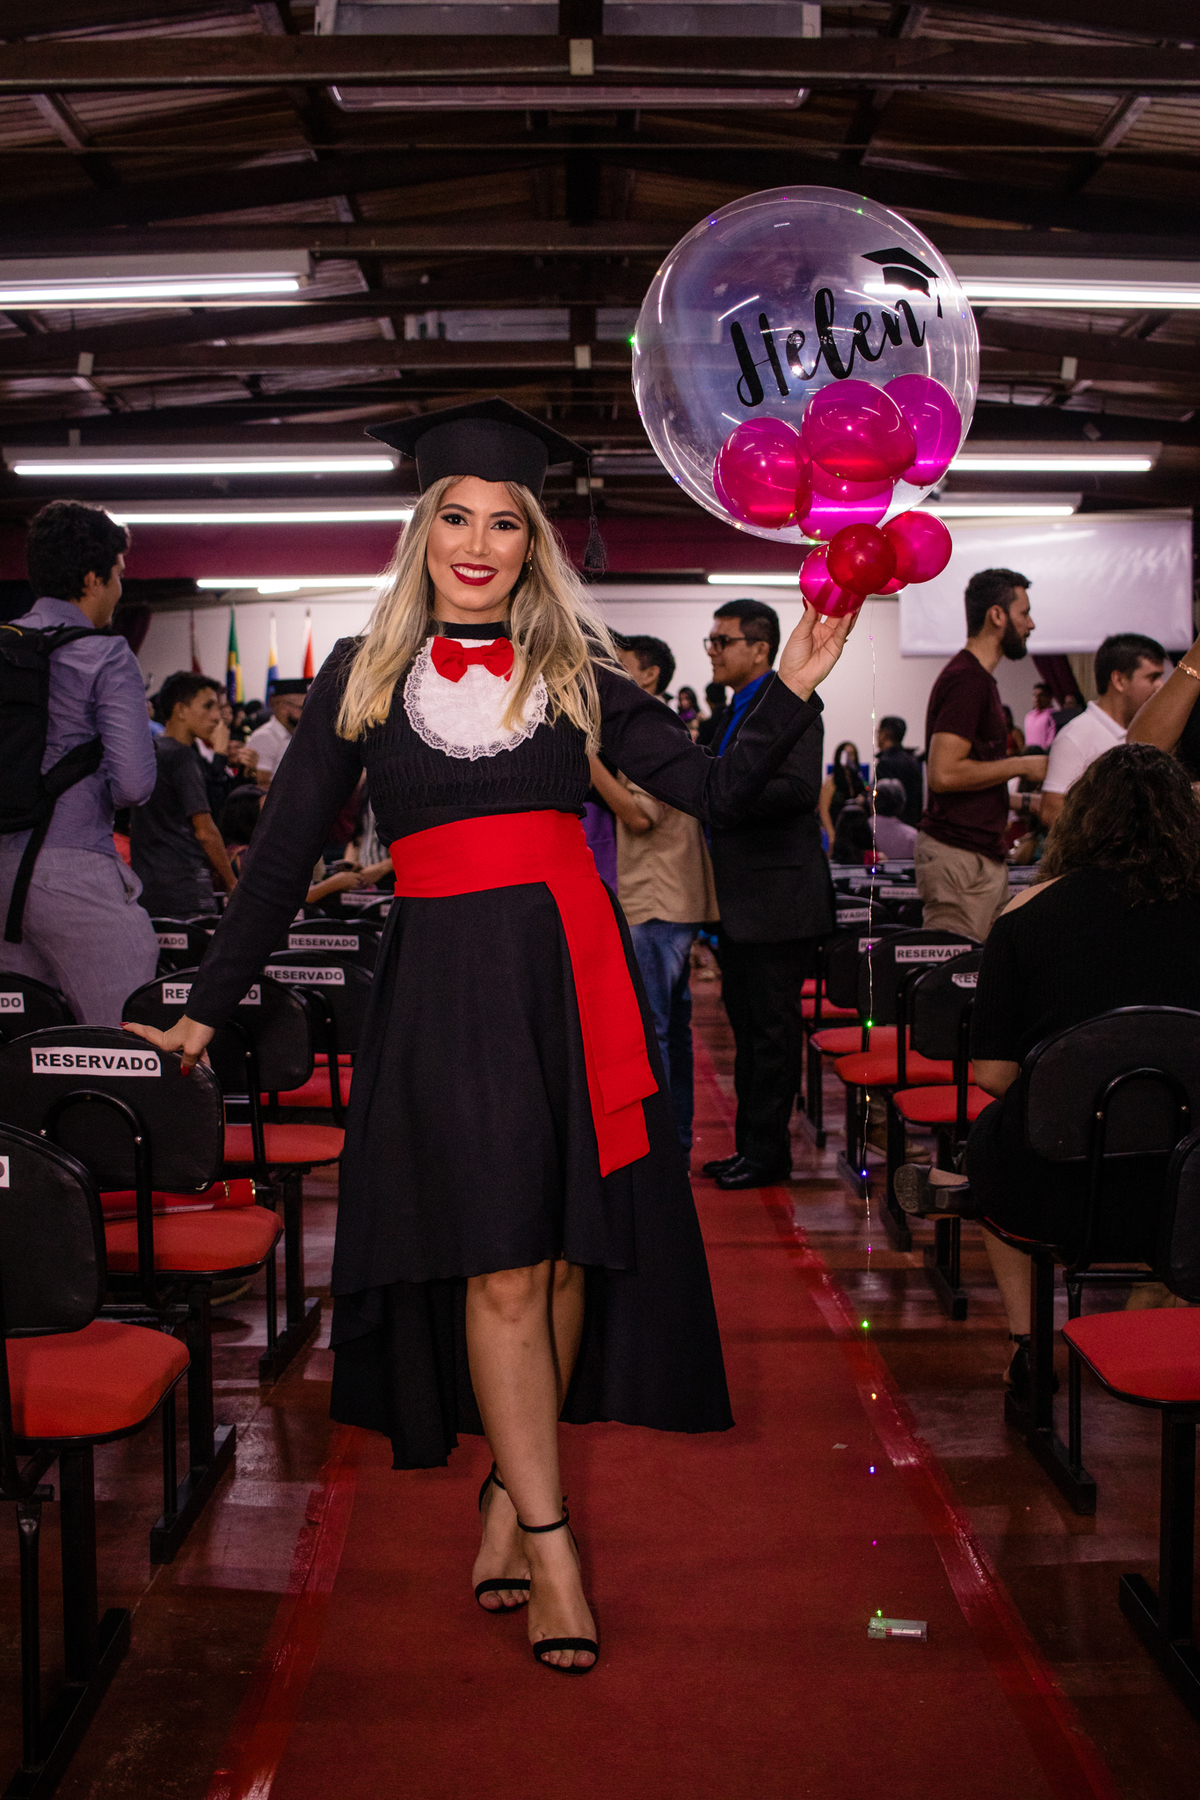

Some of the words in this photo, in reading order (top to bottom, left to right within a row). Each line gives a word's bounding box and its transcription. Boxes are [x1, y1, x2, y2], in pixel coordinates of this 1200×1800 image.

[730, 287, 926, 406] Helen
[290, 937, 358, 947] RESERVADO
[266, 970, 343, 981] RESERVADO
[35, 1053, 159, 1071] RESERVADO
